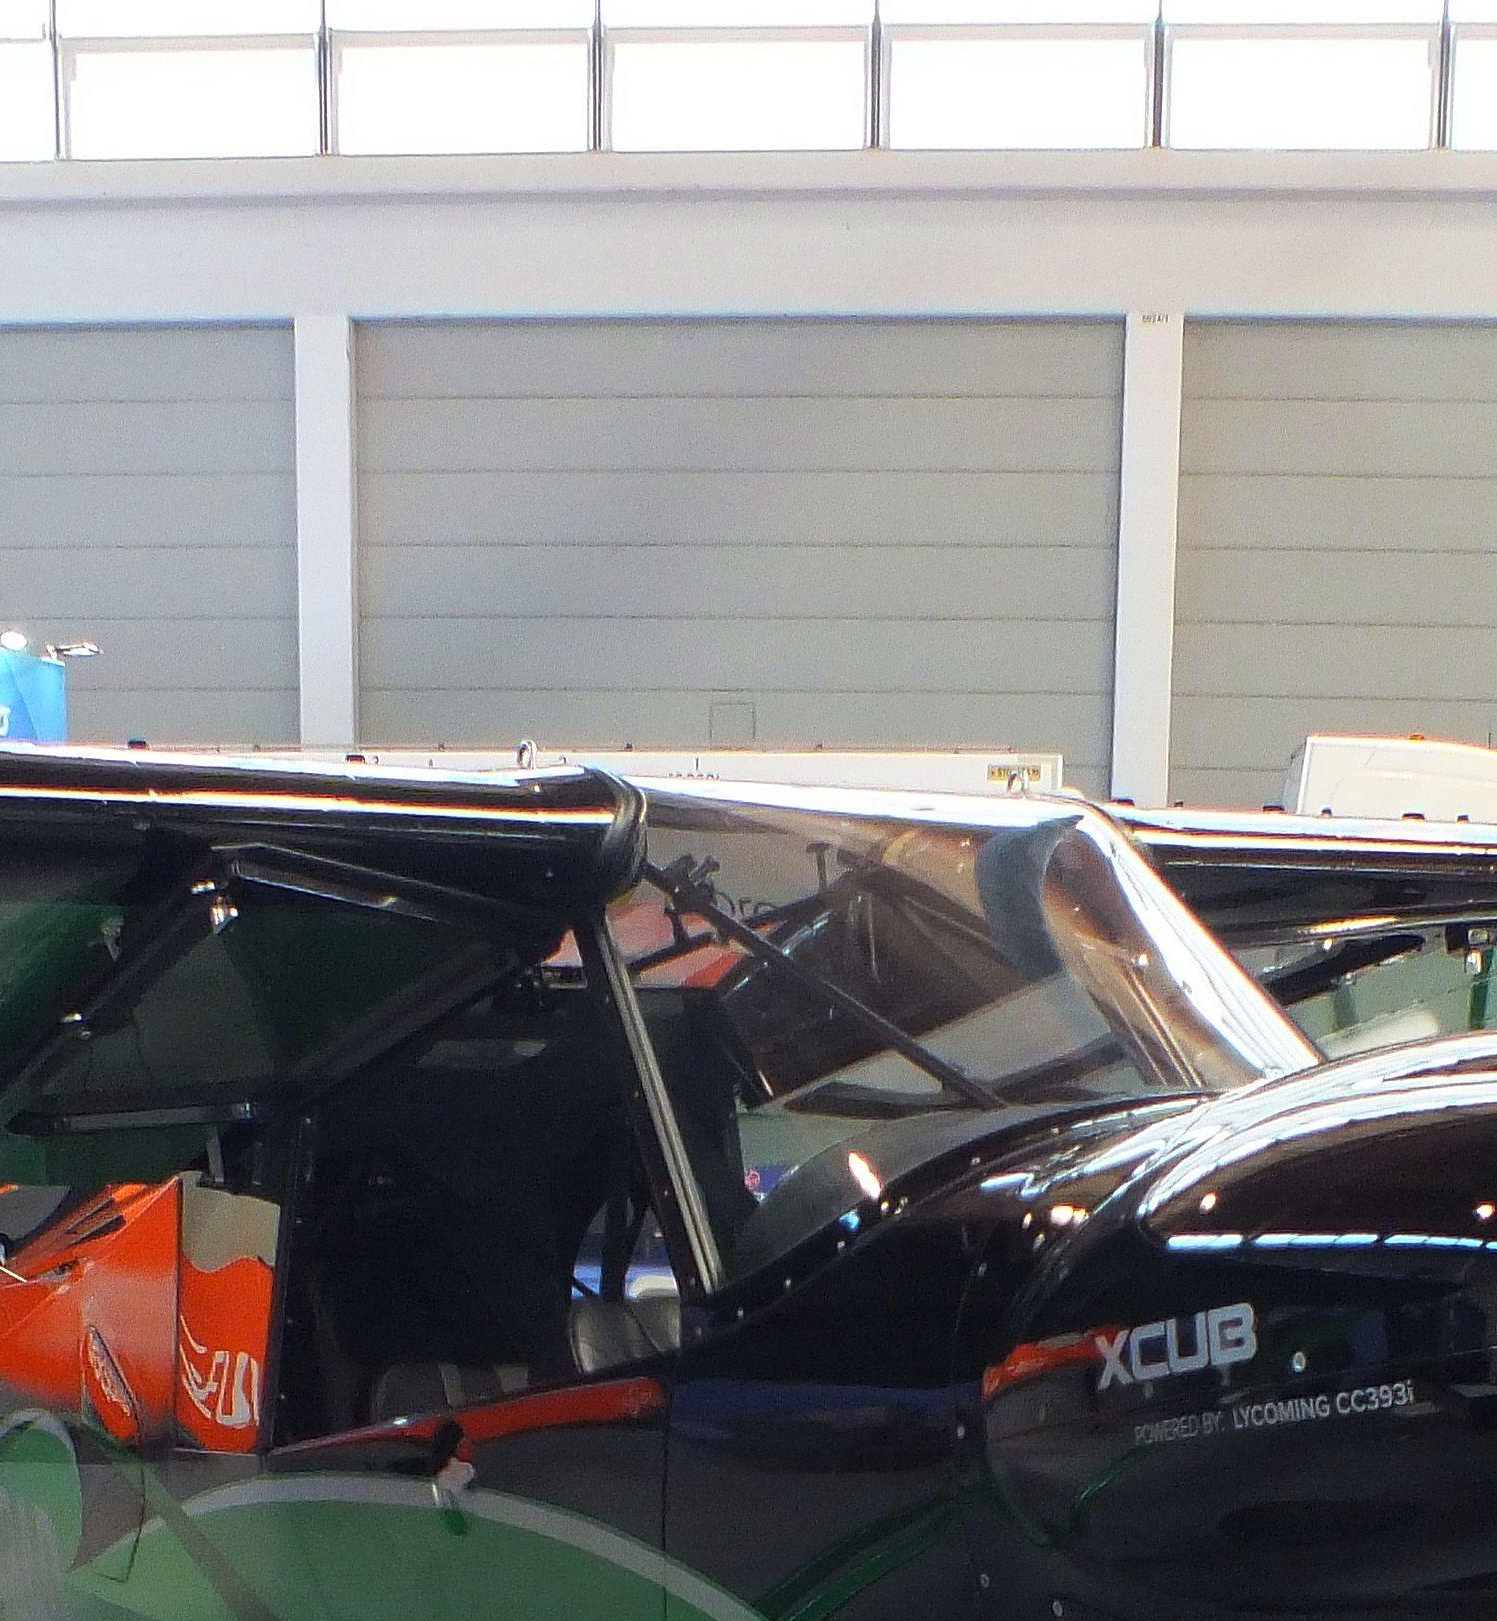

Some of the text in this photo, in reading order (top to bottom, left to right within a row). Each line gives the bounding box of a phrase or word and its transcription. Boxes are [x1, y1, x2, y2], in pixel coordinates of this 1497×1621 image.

[1094, 1302, 1259, 1392] XCUB
[1134, 1415, 1200, 1445] POWERED
[1232, 1394, 1330, 1430] LYCOMING
[1336, 1379, 1415, 1415] CC393i
